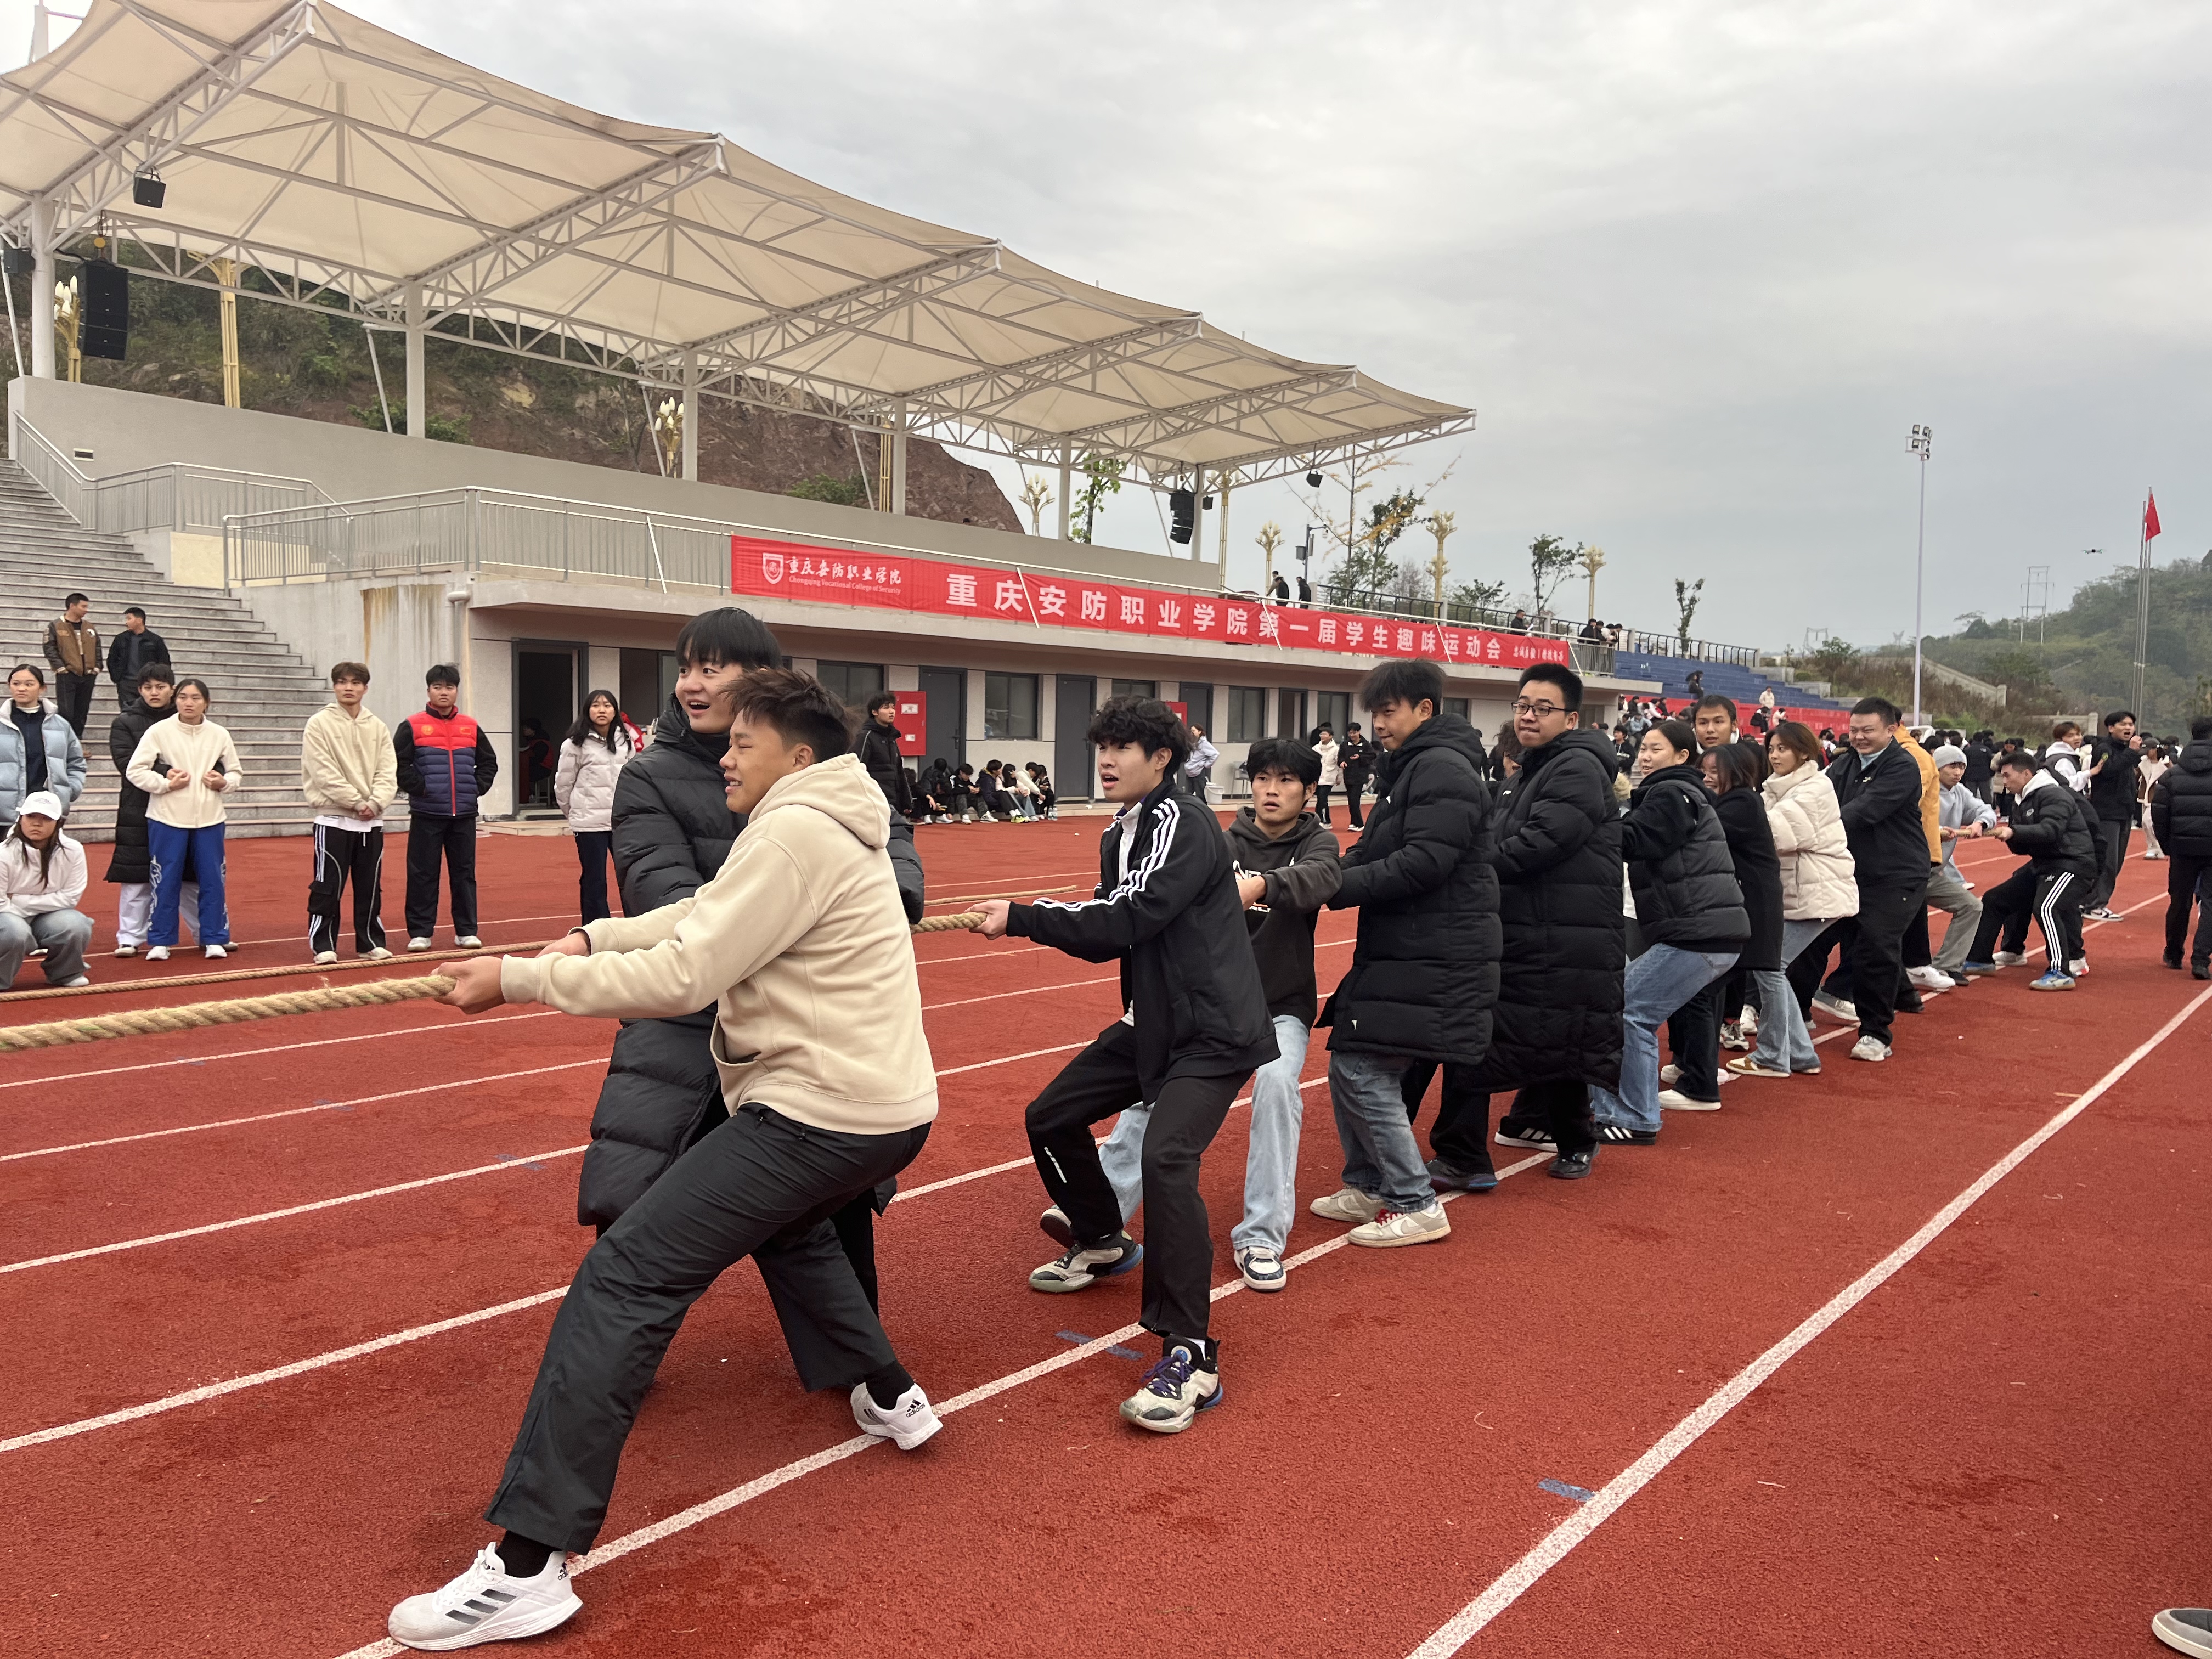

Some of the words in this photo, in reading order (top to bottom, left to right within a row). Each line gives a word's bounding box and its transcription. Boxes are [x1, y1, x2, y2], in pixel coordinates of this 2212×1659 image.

[786, 556, 901, 585] 重庆安防职业学院
[789, 575, 821, 587] Chongqing
[821, 579, 851, 589] Vocational
[851, 583, 872, 592] College
[879, 585, 901, 595] Security
[946, 573, 1500, 660] 重庆安防职业学院第一届学生趣味运动会
[906, 1403, 926, 1418] adidas
